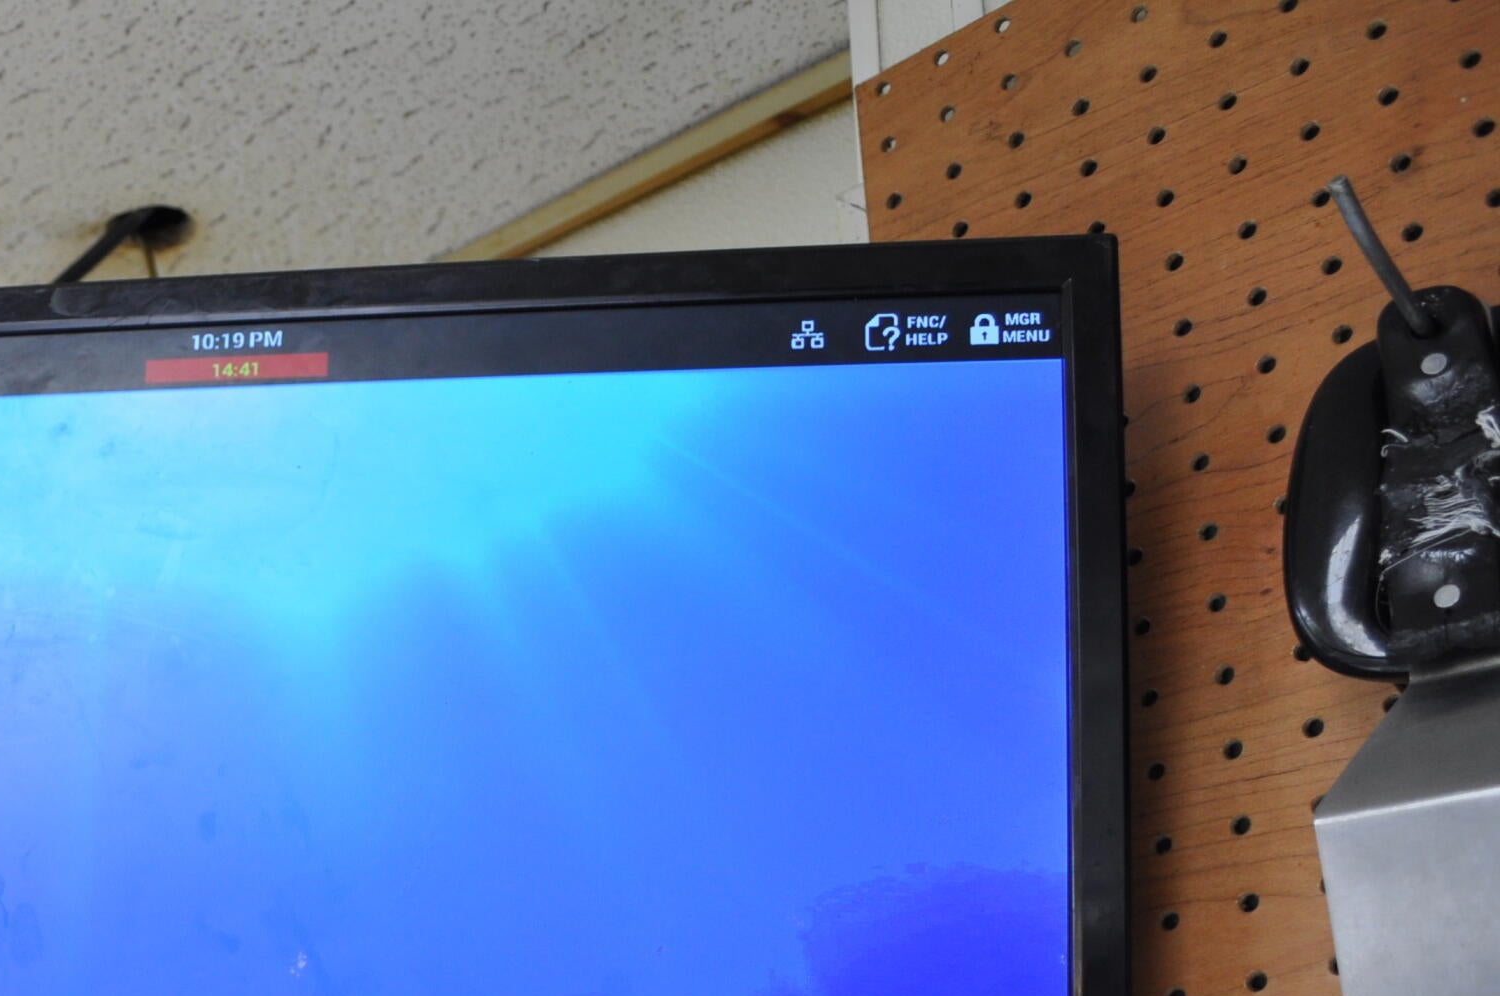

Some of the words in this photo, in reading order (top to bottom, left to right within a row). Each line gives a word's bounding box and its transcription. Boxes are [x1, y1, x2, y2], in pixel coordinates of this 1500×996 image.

[906, 314, 947, 329] FNC/
[1004, 312, 1042, 326] MGR
[192, 332, 245, 351] 10:19
[248, 330, 284, 348] PM
[905, 331, 949, 347] HELP
[1002, 328, 1051, 344] MENU
[212, 361, 260, 378] 14:41
